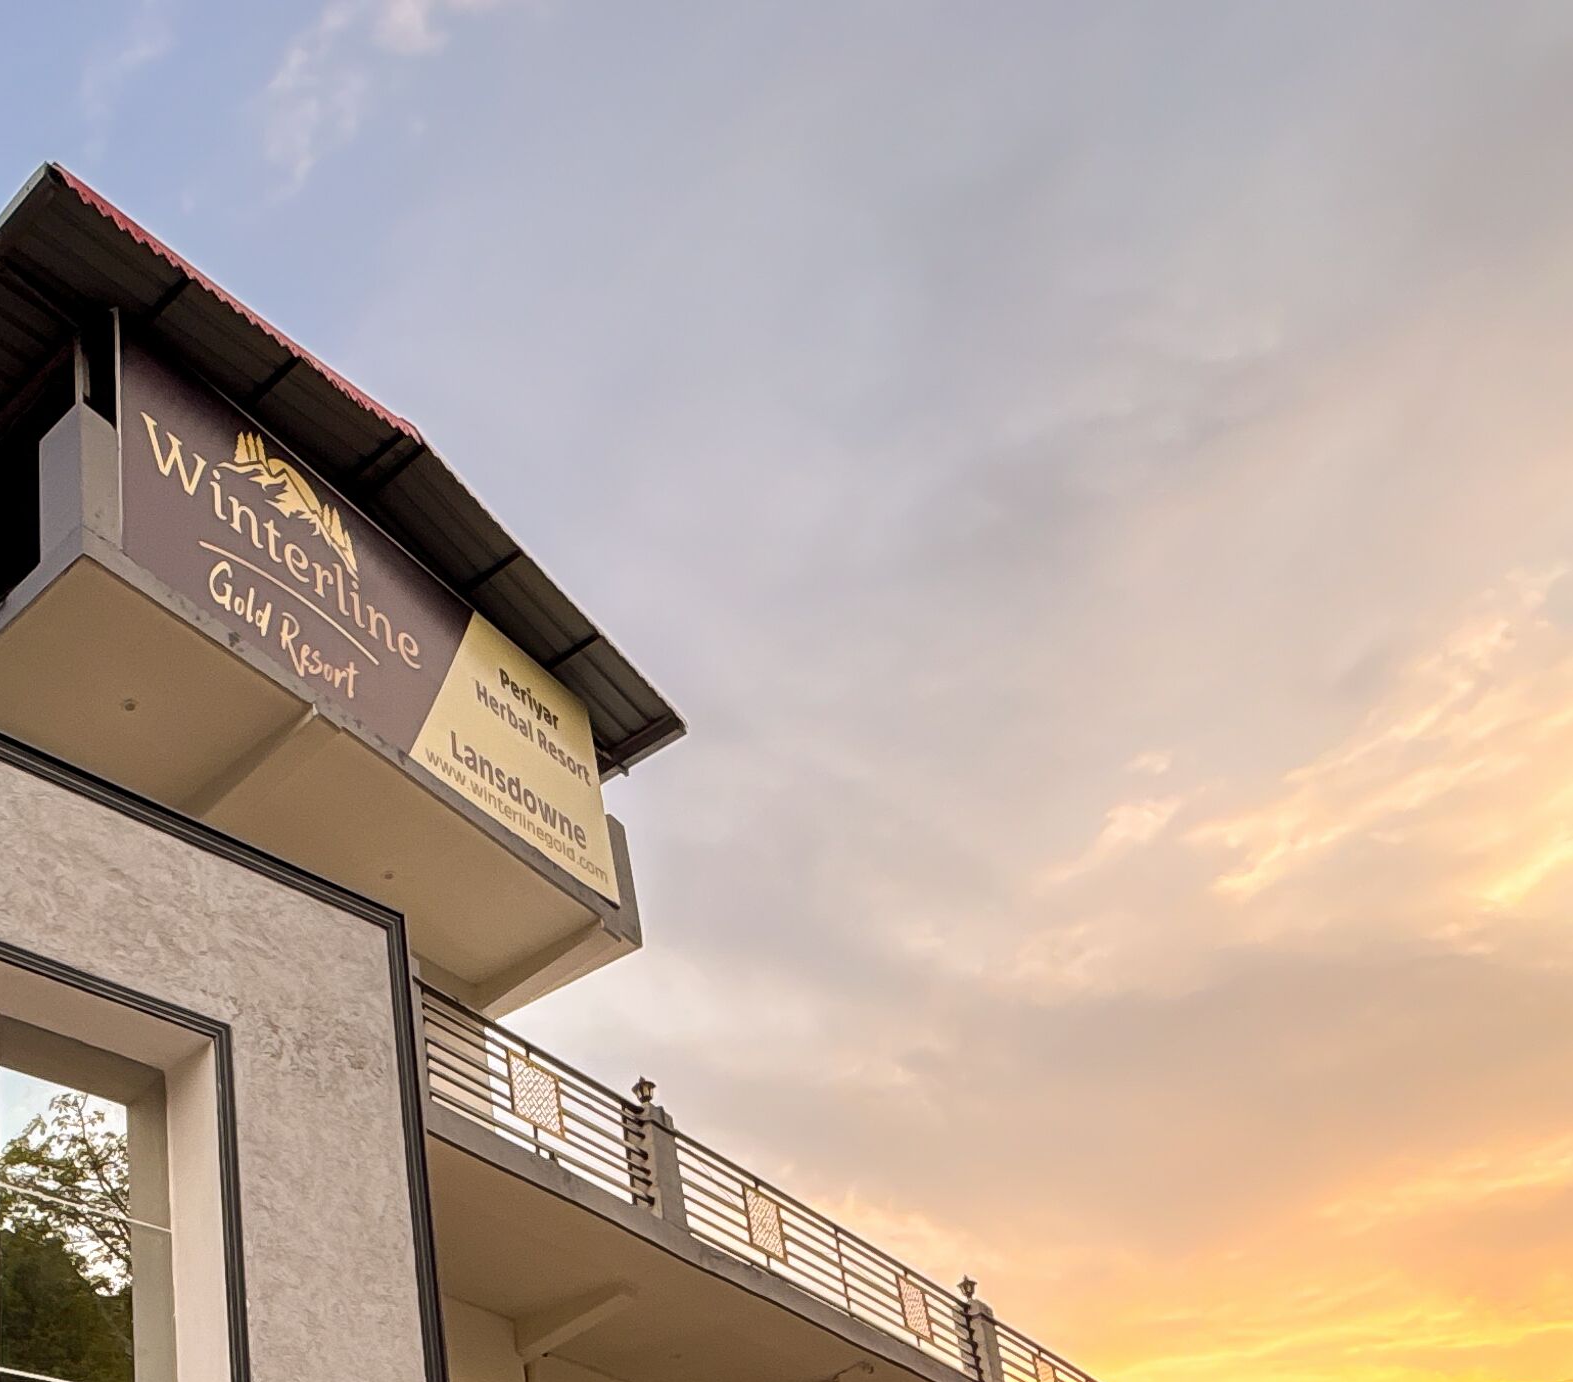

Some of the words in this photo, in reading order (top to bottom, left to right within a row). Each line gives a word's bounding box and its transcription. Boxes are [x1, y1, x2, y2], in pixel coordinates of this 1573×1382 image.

[140, 411, 421, 669] Winterline
[208, 560, 272, 637] Gold
[279, 612, 359, 698] Resort
[474, 680, 534, 742] Herbal
[536, 728, 592, 787] Resort
[499, 667, 559, 730] Periyar
[425, 747, 610, 884] www.winterlinegold.com
[450, 730, 588, 850] Lansdowne
